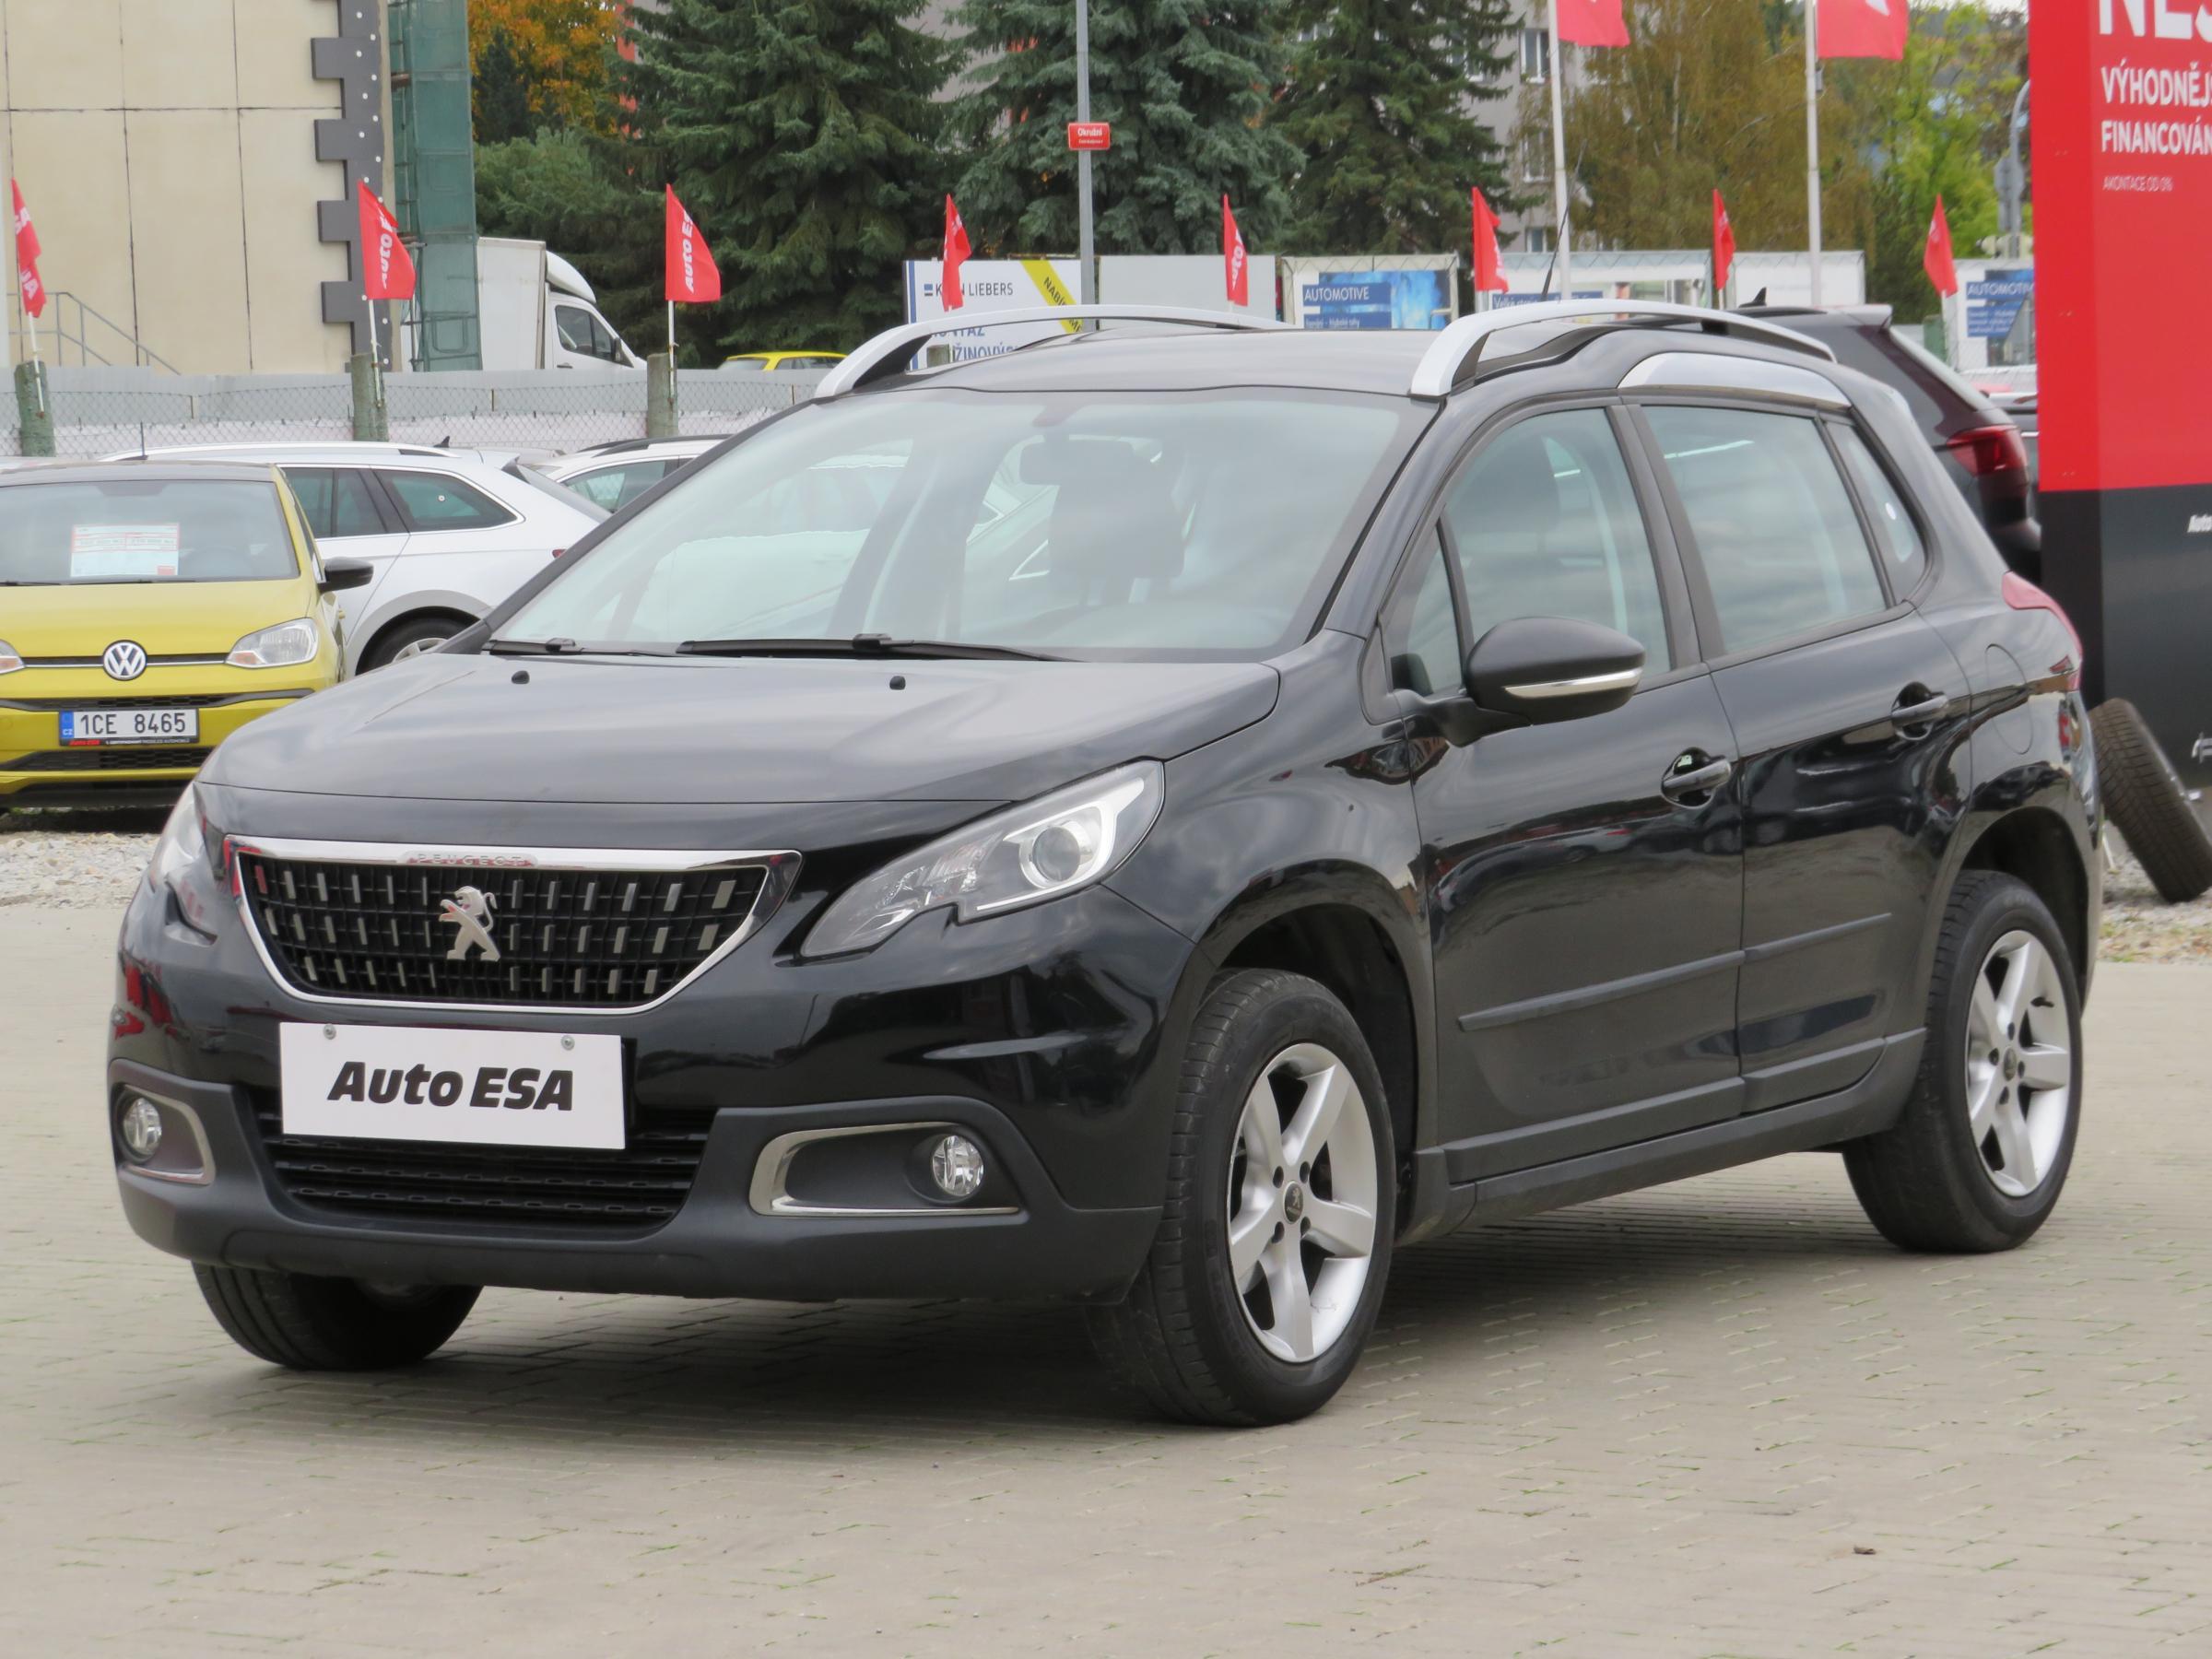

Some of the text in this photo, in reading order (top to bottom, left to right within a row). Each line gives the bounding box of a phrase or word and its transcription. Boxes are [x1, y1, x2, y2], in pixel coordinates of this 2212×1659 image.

[2100, 57, 2212, 107] VÝHODNĚJ
[969, 282, 1014, 296] LIEBERS
[1304, 286, 1370, 301] AUTOMOTIVE
[80, 712, 186, 735] 1CE 8465
[418, 853, 523, 866] PEUGEOT
[326, 1061, 573, 1112] Auto ESA
